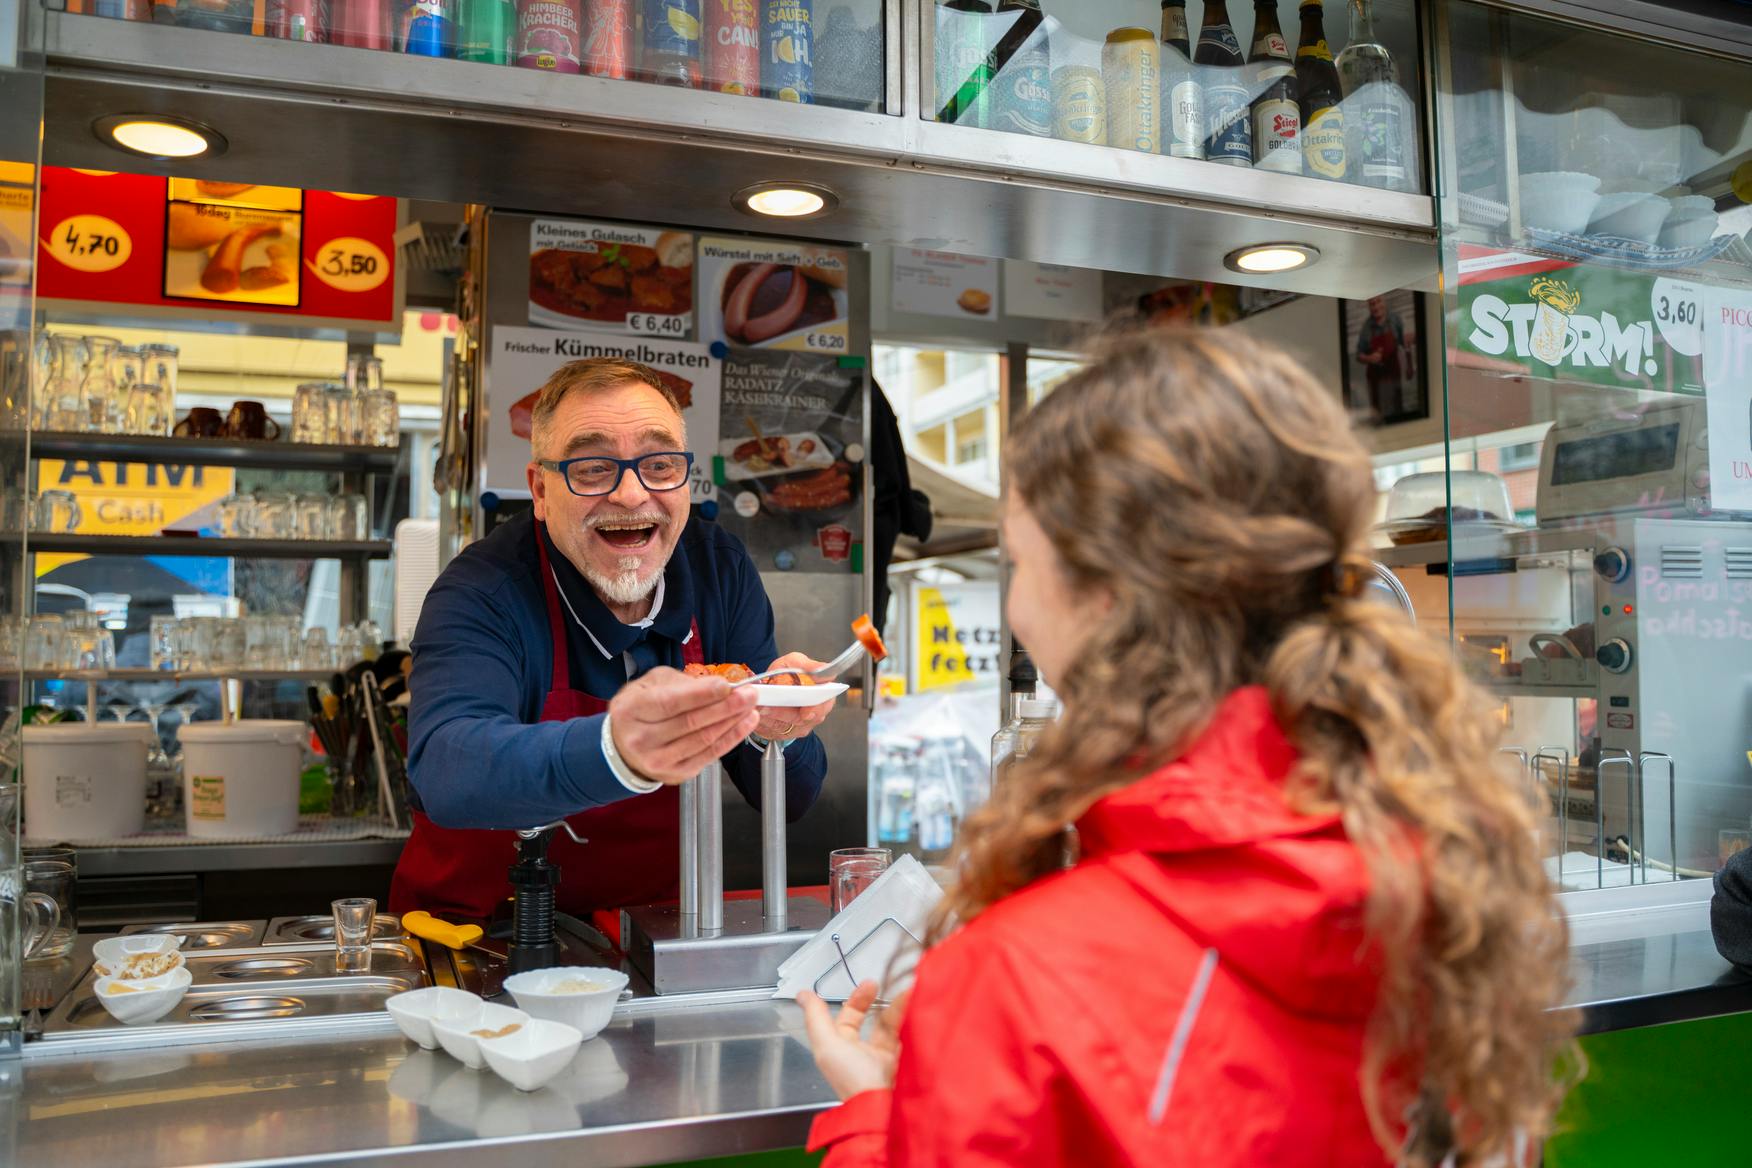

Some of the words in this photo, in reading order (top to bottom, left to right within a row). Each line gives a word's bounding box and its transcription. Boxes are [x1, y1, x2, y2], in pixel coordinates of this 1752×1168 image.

[66, 224, 119, 258] 4,70
[536, 240, 554, 250] mit
[537, 224, 587, 240] Kleines
[592, 229, 646, 245] Gulasch
[321, 250, 376, 277] 3,50
[704, 247, 751, 261] Würstel
[754, 252, 774, 262] mit
[1658, 295, 1696, 325] 3,60
[630, 315, 642, 330] €
[646, 316, 683, 334] 6,40
[806, 334, 815, 346] €
[817, 335, 844, 349] 6,20
[505, 342, 551, 355] Frischer
[554, 339, 710, 369] Kümmelbraten
[725, 377, 784, 392] RADATZ
[98, 500, 164, 525] Cash
[931, 624, 998, 646] Netz
